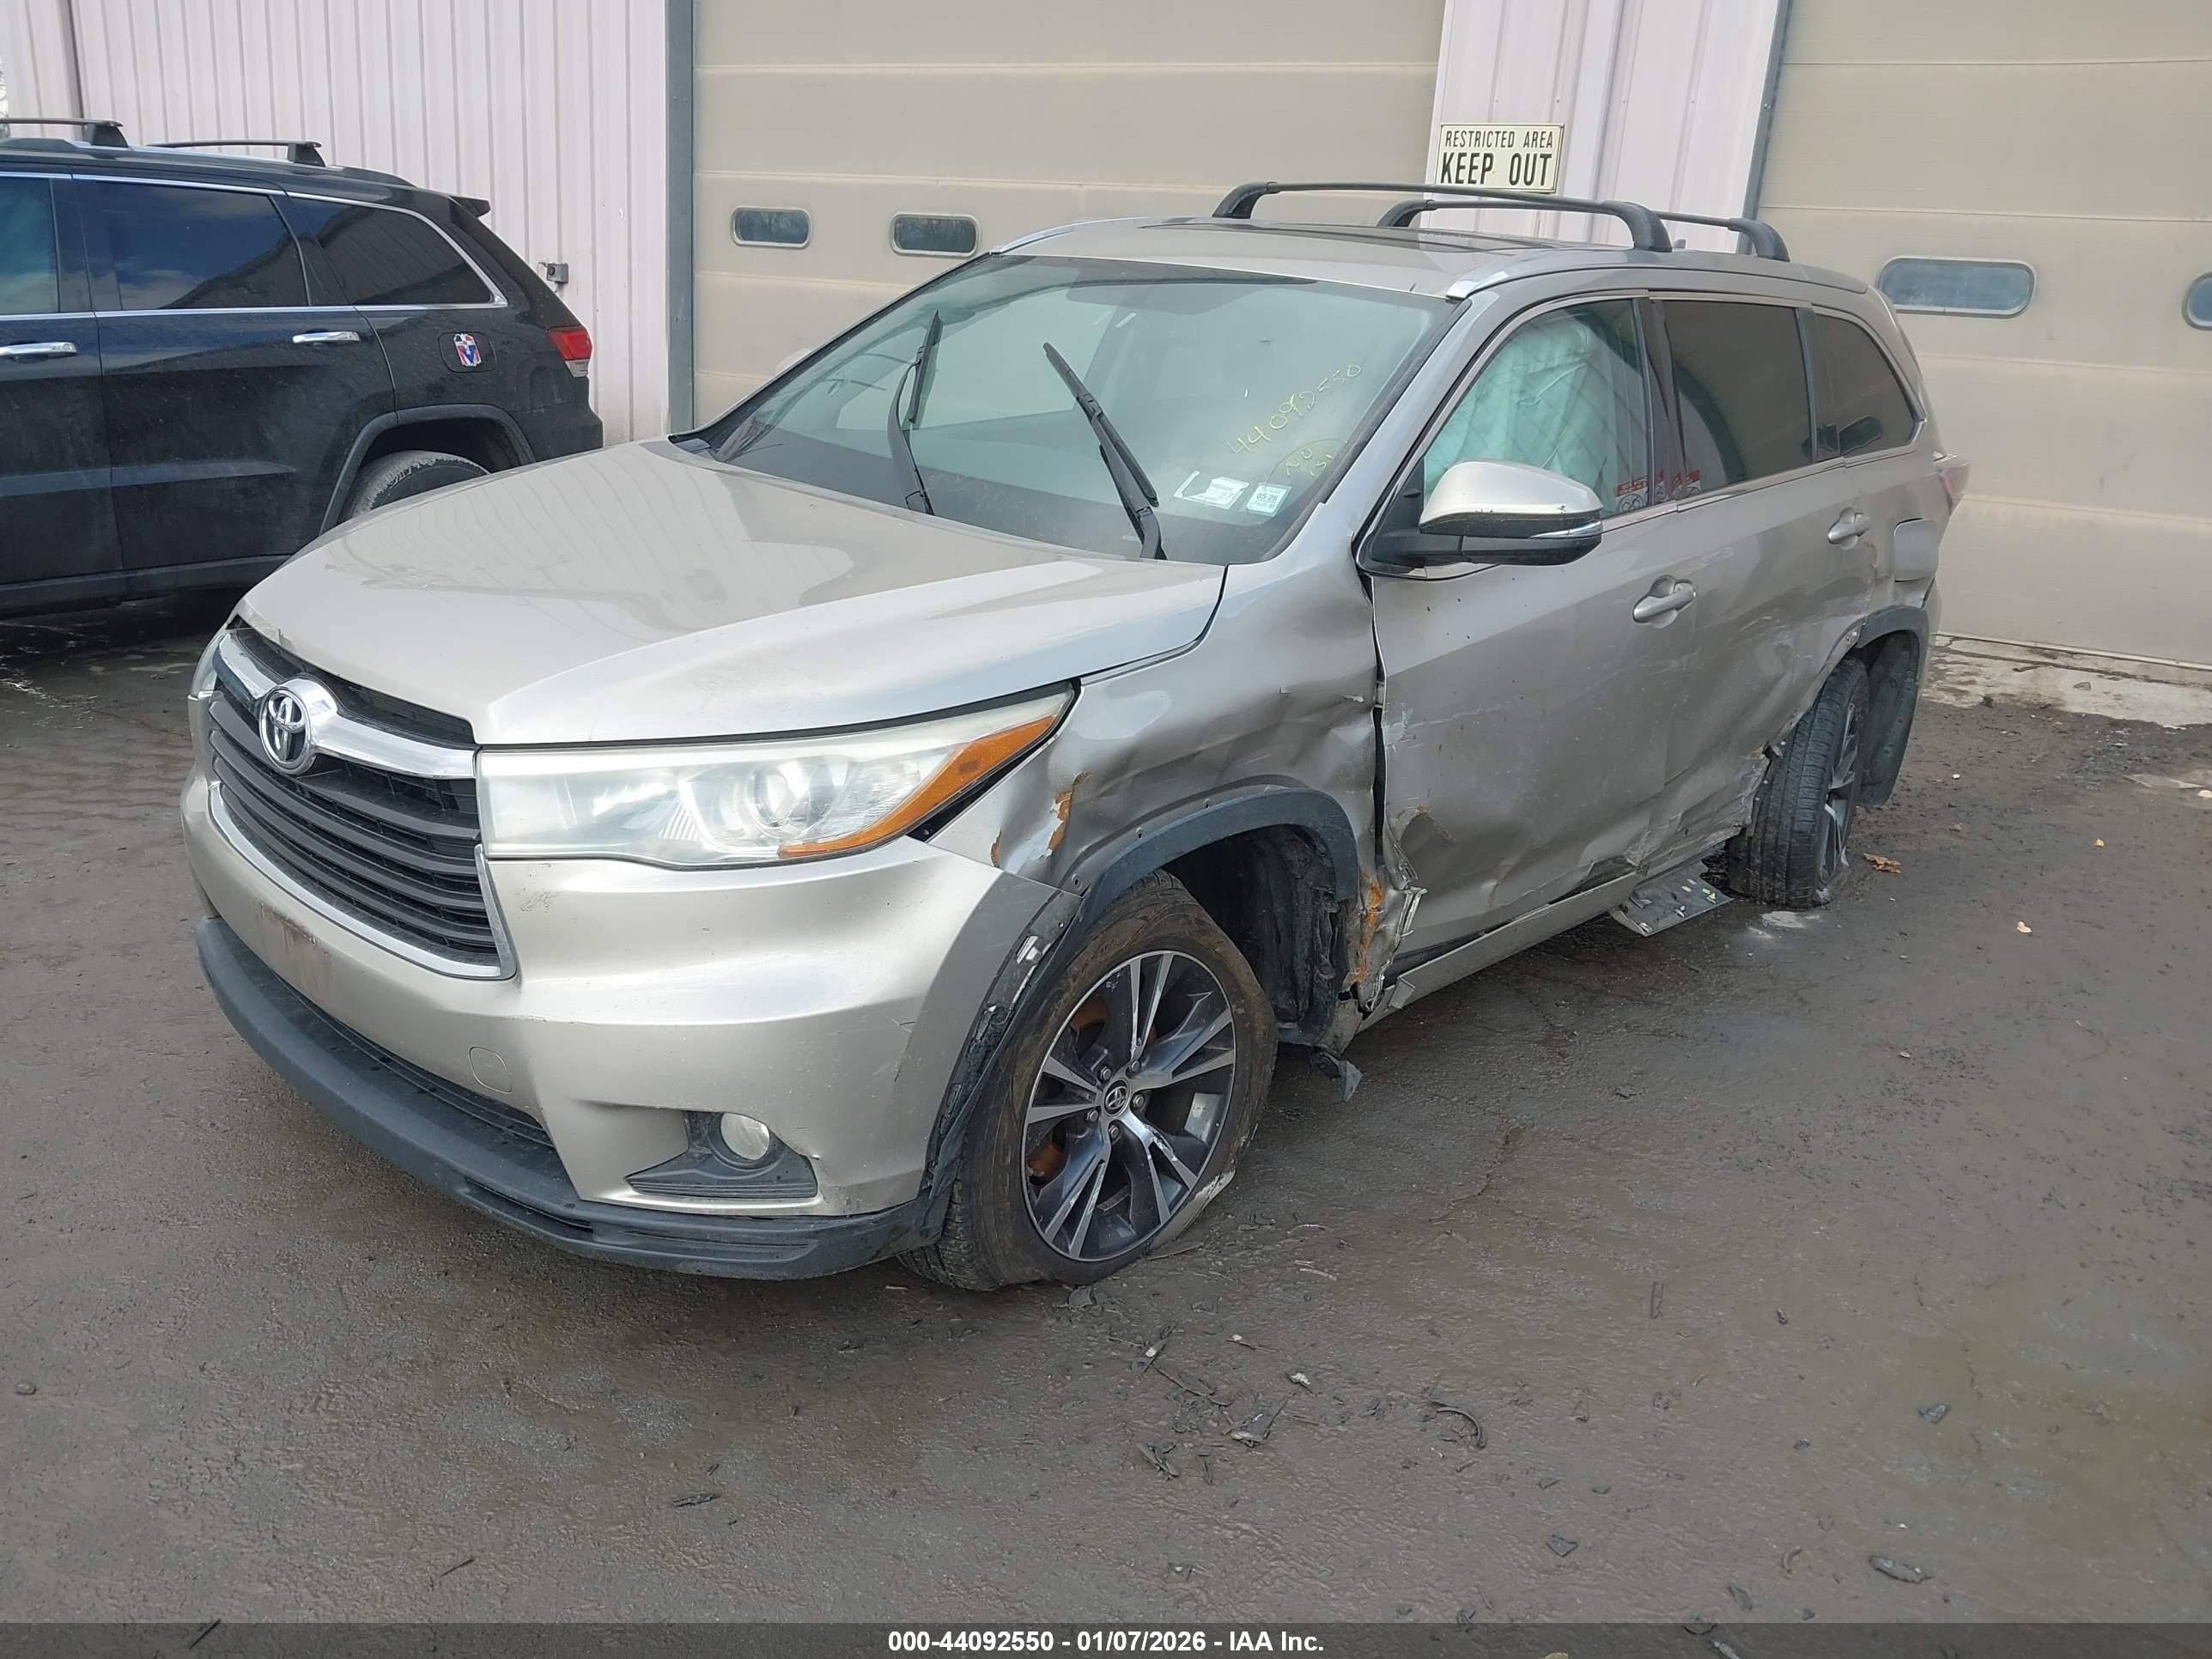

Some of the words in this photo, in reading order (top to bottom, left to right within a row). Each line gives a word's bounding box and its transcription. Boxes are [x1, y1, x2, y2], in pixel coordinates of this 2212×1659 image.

[1444, 130, 1516, 149] RESTRICTED
[1522, 131, 1553, 149] AREA
[1440, 152, 1495, 185] KEEP
[1508, 153, 1553, 186] OUT
